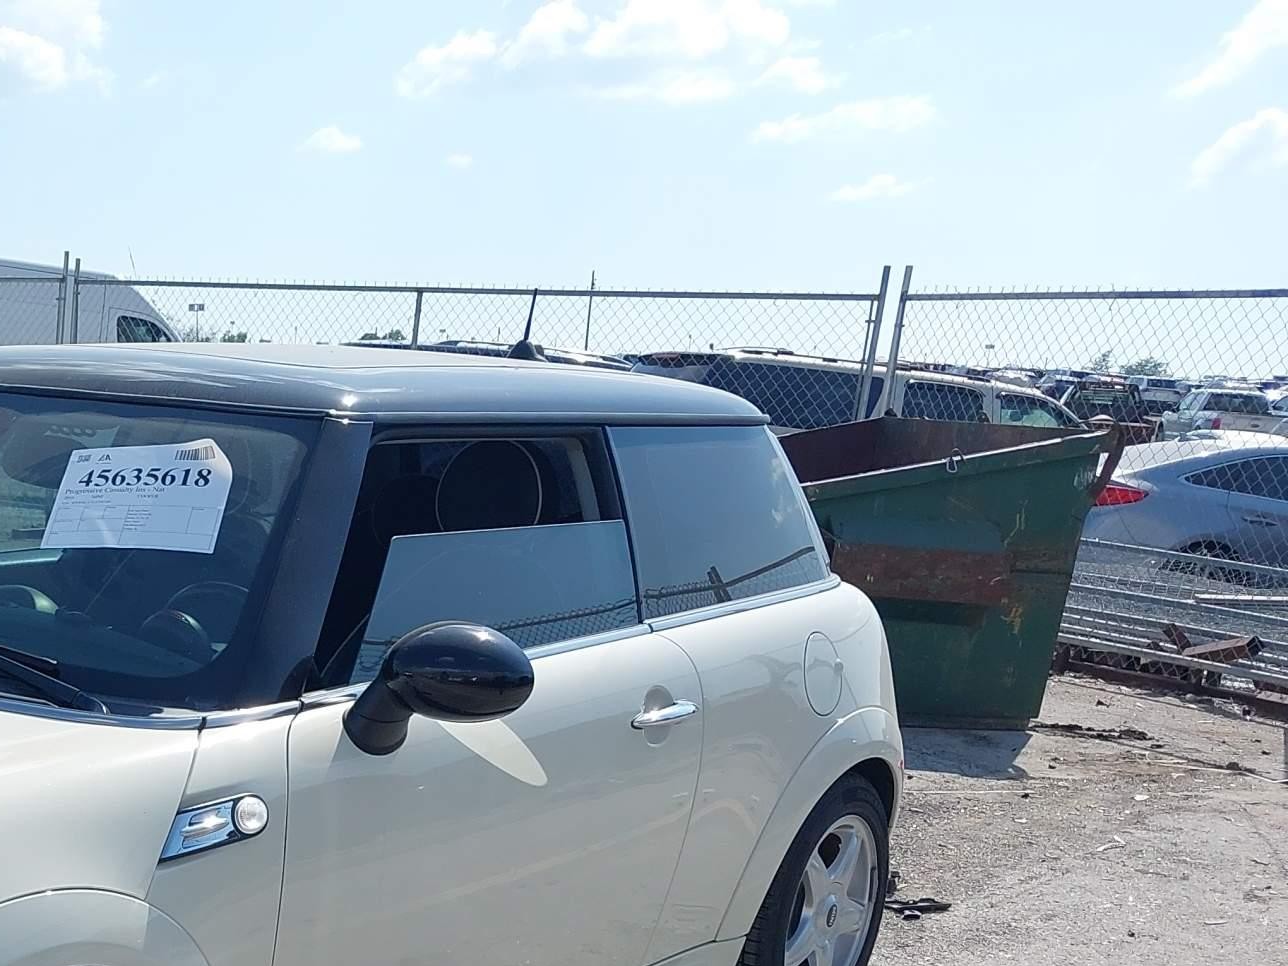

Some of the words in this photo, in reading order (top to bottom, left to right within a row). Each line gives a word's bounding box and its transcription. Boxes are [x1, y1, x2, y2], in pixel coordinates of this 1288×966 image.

[78, 467, 212, 487] 45635618
[64, 487, 103, 496] Progressive
[104, 486, 134, 495] Casualty
